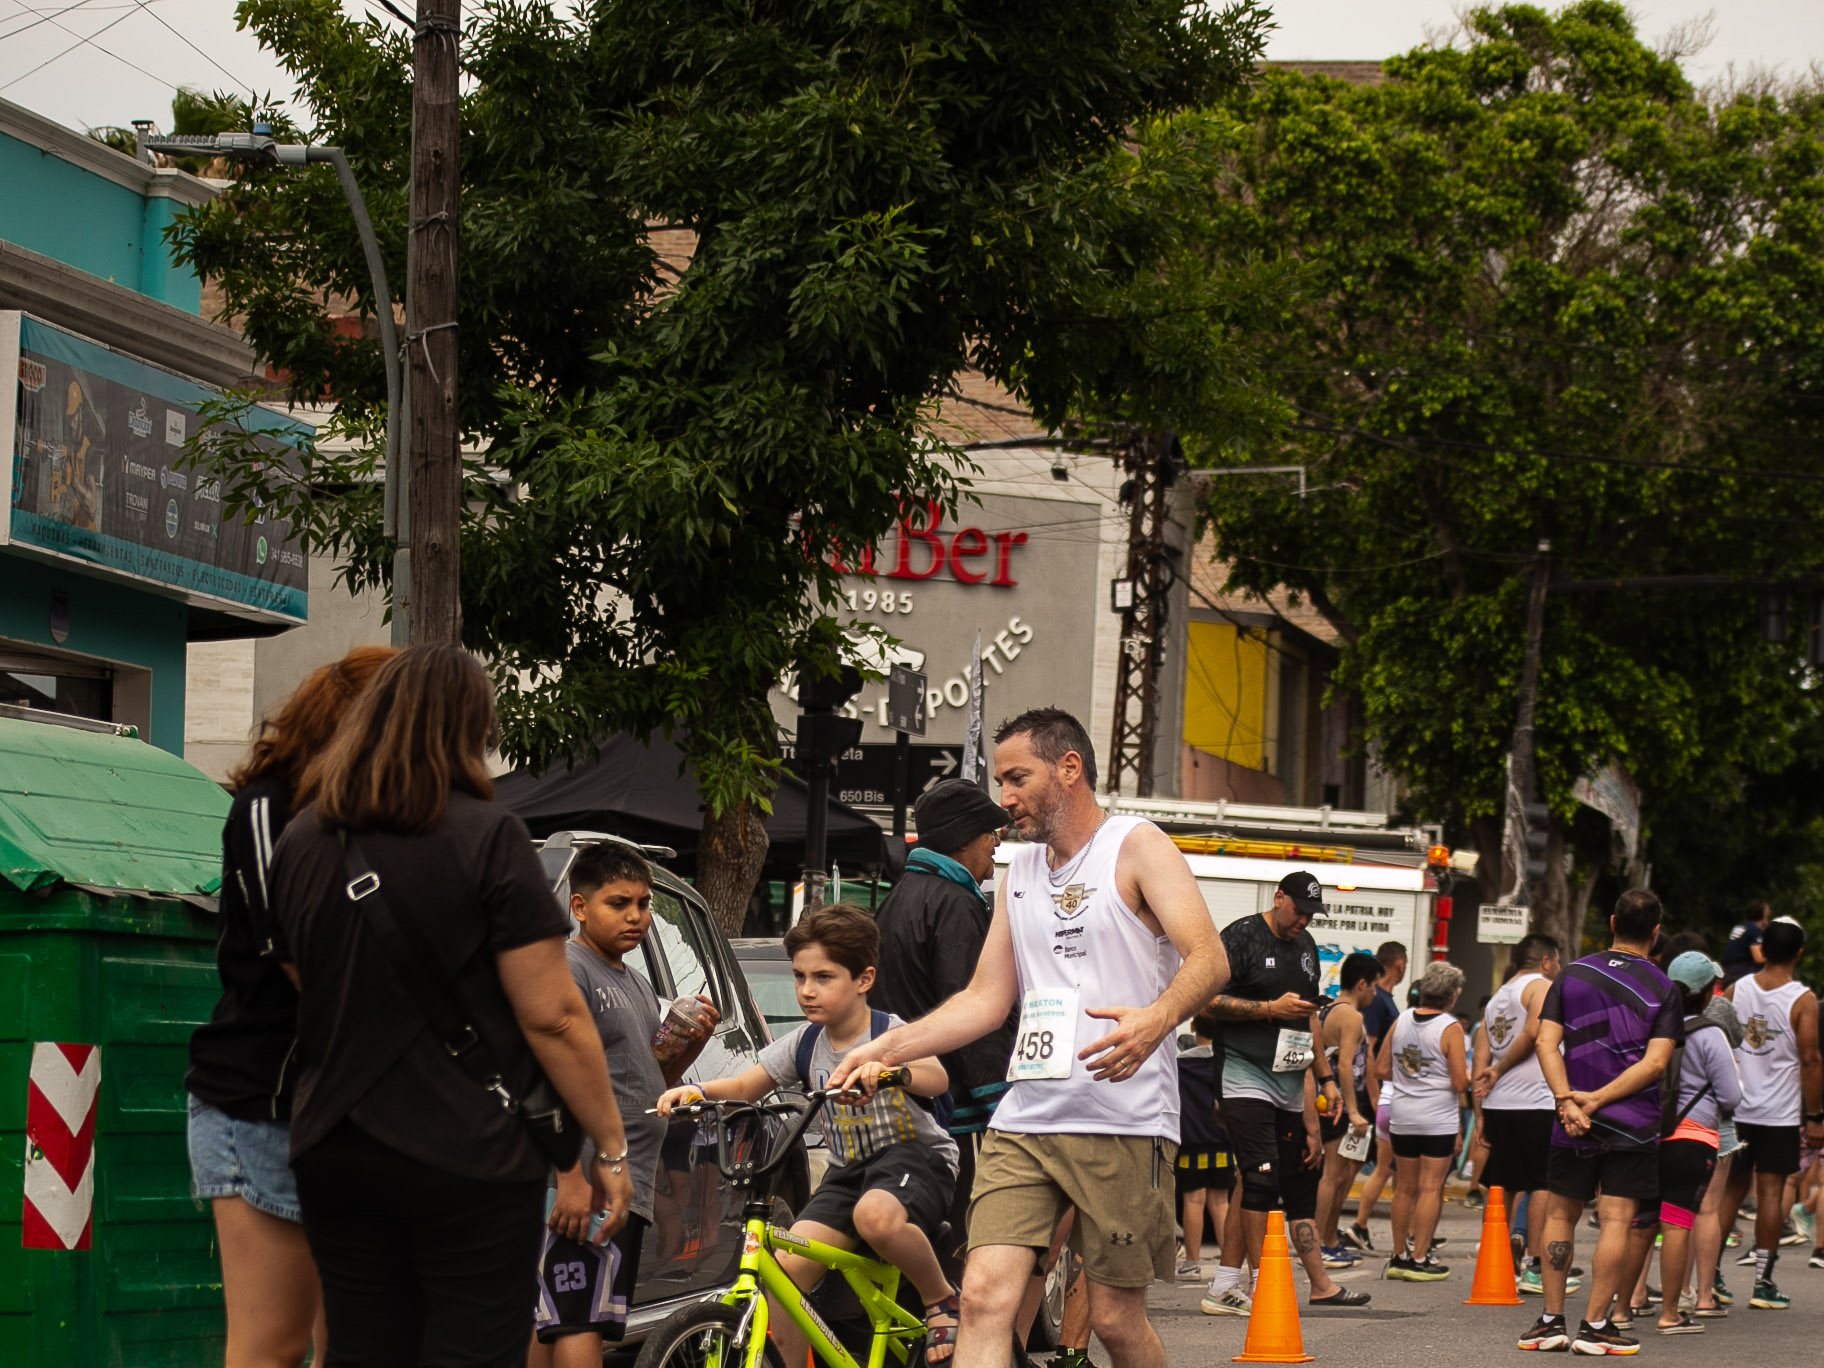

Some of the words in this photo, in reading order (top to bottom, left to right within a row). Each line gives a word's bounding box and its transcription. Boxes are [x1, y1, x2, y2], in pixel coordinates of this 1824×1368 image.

[846, 589, 914, 615] 1985
[839, 790, 863, 803] 650
[864, 790, 885, 803] Bis
[1065, 899, 1078, 910] 40
[1333, 904, 1343, 914] LA
[1339, 920, 1356, 931] POR
[1358, 921, 1368, 932] LA
[1370, 922, 1390, 934] VIDA
[1064, 946, 1077, 954] Banco
[1064, 950, 1087, 960] Municipal
[1017, 1030, 1054, 1061] 458
[553, 1261, 587, 1293] 23
